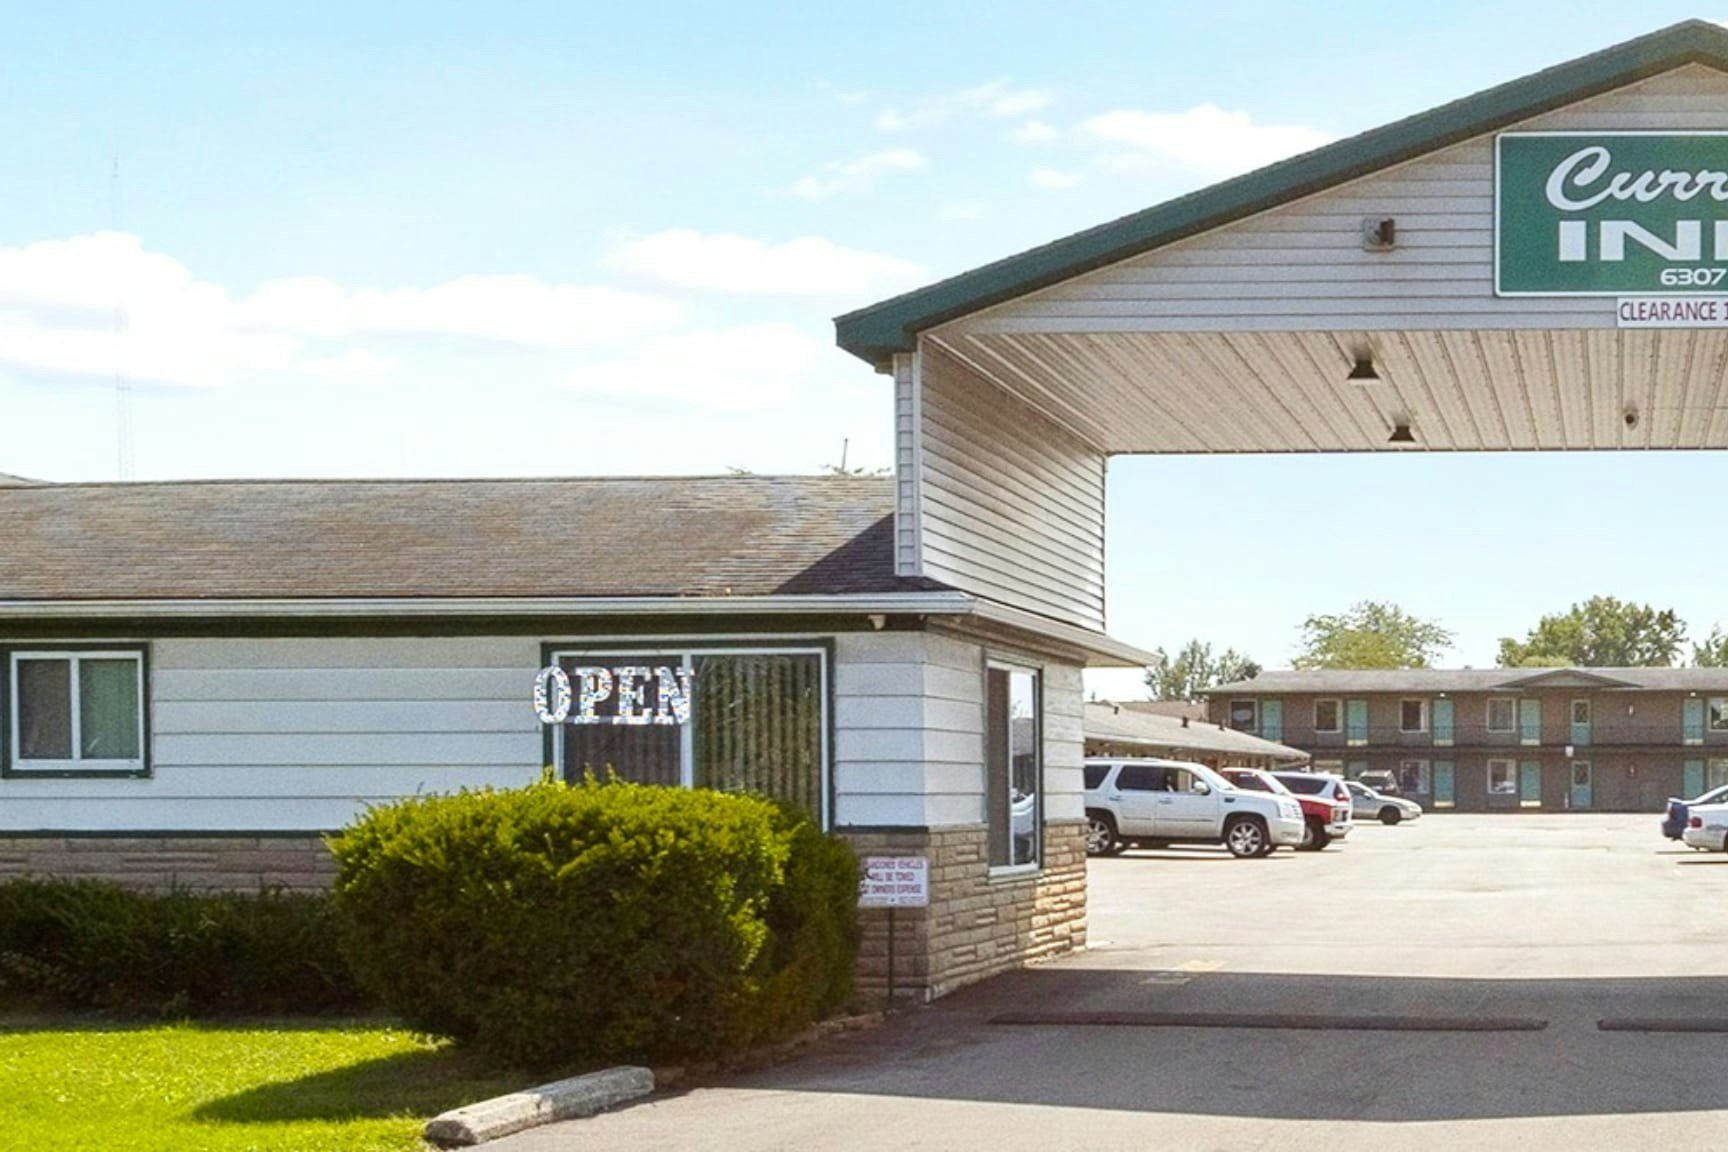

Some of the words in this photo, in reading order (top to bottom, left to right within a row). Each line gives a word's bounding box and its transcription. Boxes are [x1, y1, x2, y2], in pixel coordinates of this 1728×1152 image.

[1659, 268, 1728, 286] 6307
[1619, 301, 1718, 321] CLEARANCE
[533, 665, 695, 724] OPEN
